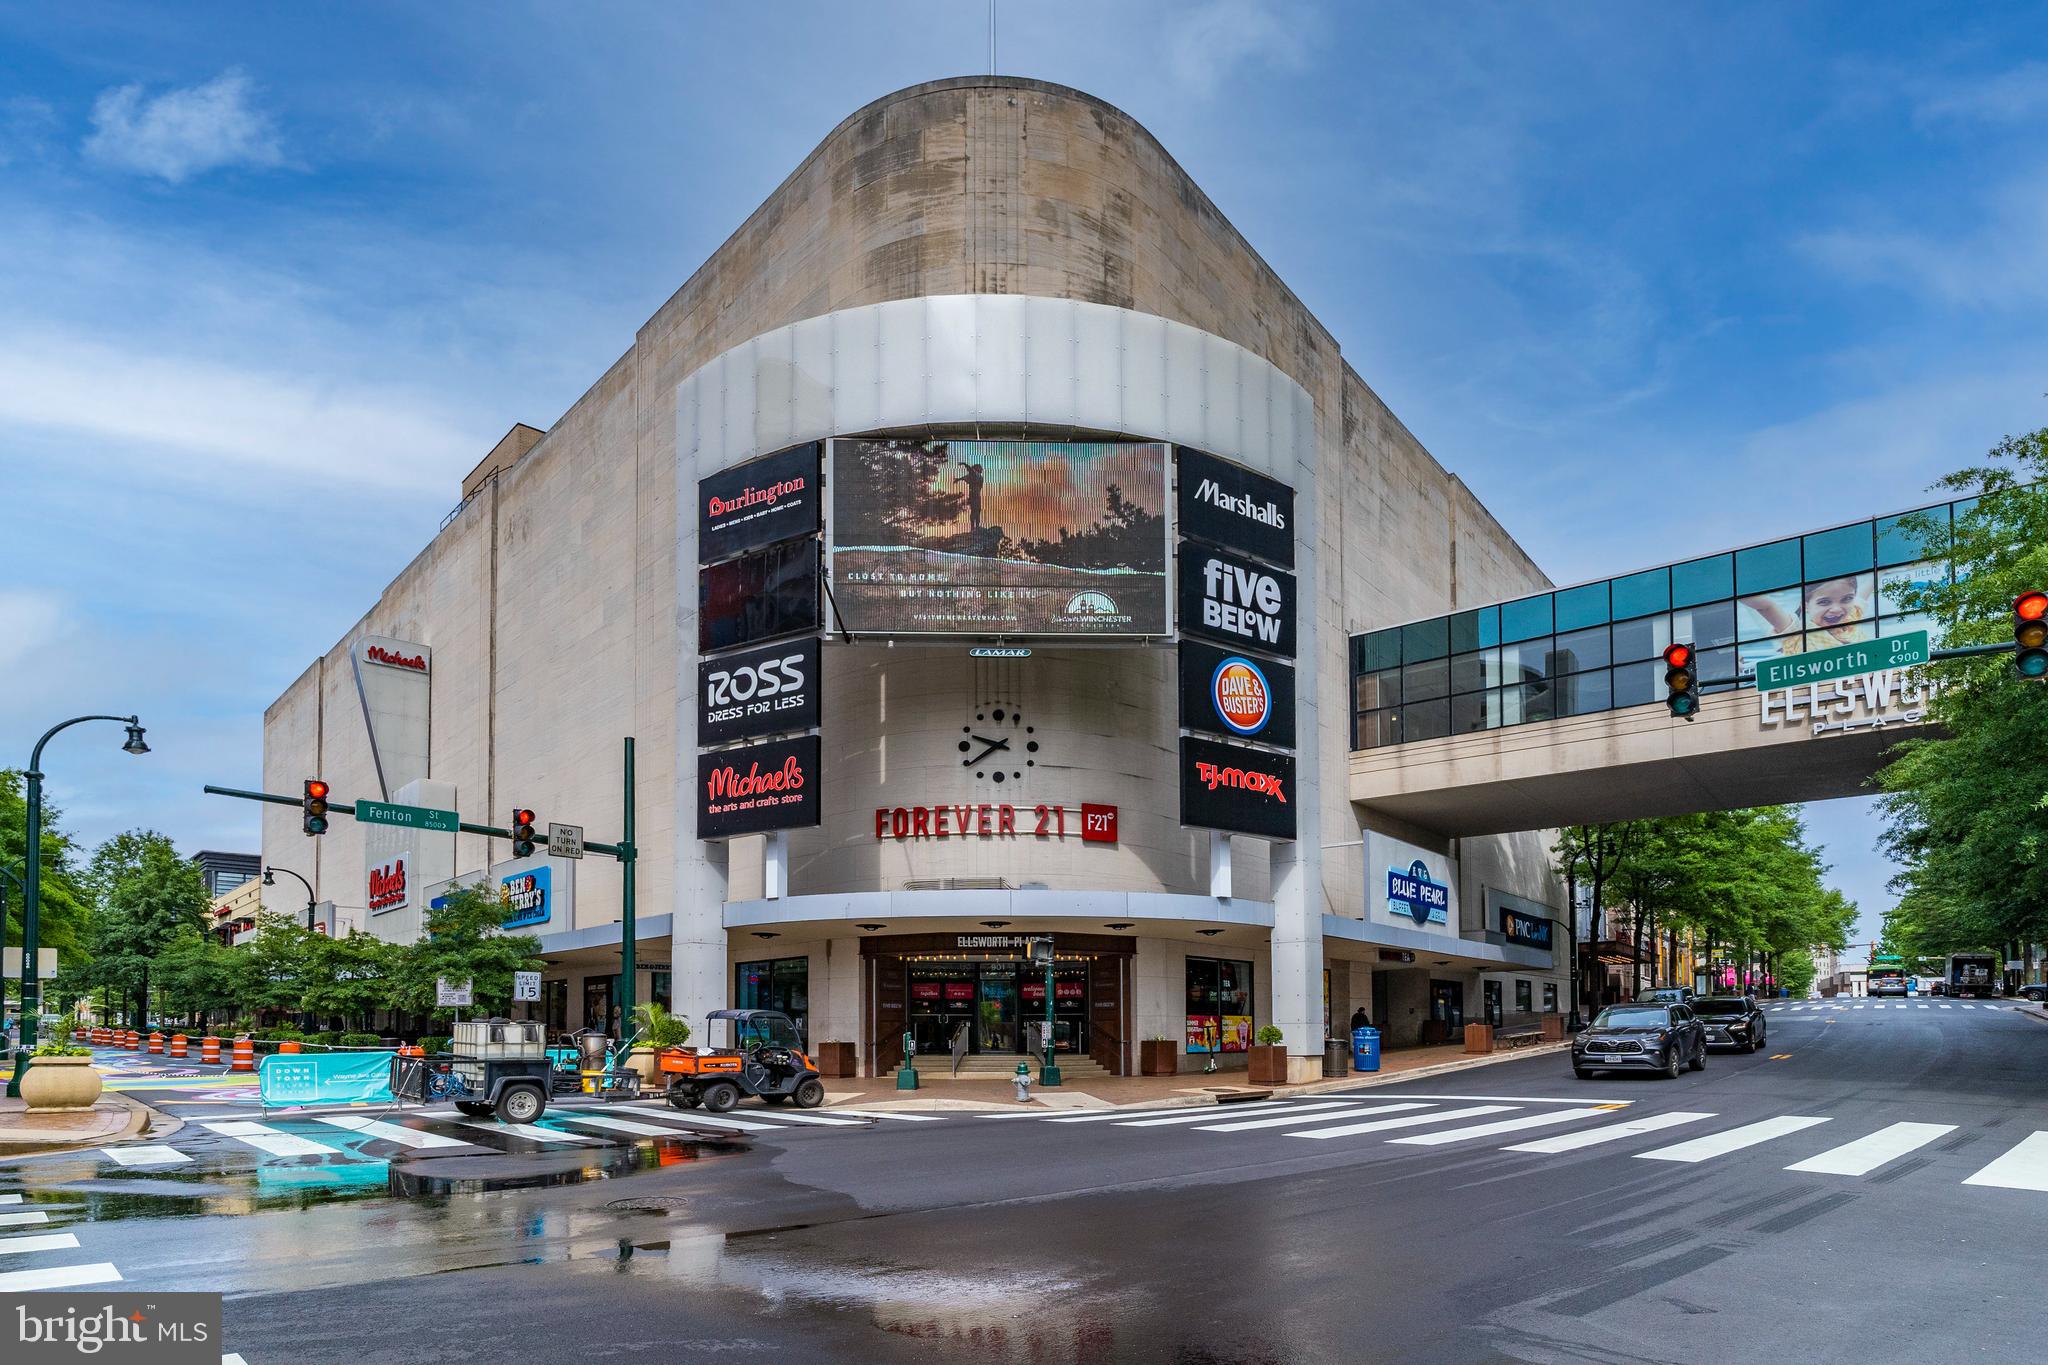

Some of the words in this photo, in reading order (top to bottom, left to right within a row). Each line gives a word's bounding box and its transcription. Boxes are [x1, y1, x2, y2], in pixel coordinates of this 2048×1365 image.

[709, 477, 805, 517] Burlington
[1194, 478, 1285, 530] Marshalls
[848, 572, 884, 580] CLOSE
[1203, 558, 1281, 615] five
[900, 590, 922, 598] BUT
[929, 590, 982, 598] NOTHING
[987, 591, 1015, 599] LIKE
[1891, 639, 1911, 653] Dr
[368, 645, 427, 671] Michaels
[1769, 650, 1868, 683] Ellsworth
[1897, 651, 1920, 664] 900
[708, 654, 805, 707] ROSS
[1221, 675, 1255, 697] DAVE
[1253, 678, 1263, 697] &
[708, 706, 743, 723] DRESS
[747, 701, 770, 716] FOR
[775, 694, 804, 711] LESS
[1222, 696, 1264, 715] BUSTER'S
[1812, 709, 1922, 735] PLAC
[708, 755, 804, 801] Michaels
[369, 806, 412, 822] Fenton
[429, 810, 440, 820] St
[709, 804, 722, 814] the
[723, 802, 738, 811] arts
[740, 799, 754, 809] and
[756, 795, 779, 807] crafts
[781, 794, 803, 804] store
[876, 803, 1016, 839] FOREVER
[1034, 804, 1065, 838] 21
[551, 845, 563, 853] ON
[565, 846, 581, 855] RED
[556, 836, 577, 846] TURN
[510, 876, 526, 896] BEN
[1392, 877, 1418, 899] BLUE
[1420, 884, 1446, 907] PEARL
[1514, 918, 1530, 938] PNC
[957, 936, 1009, 948] ELLSWORTH
[521, 987, 537, 998] 15
